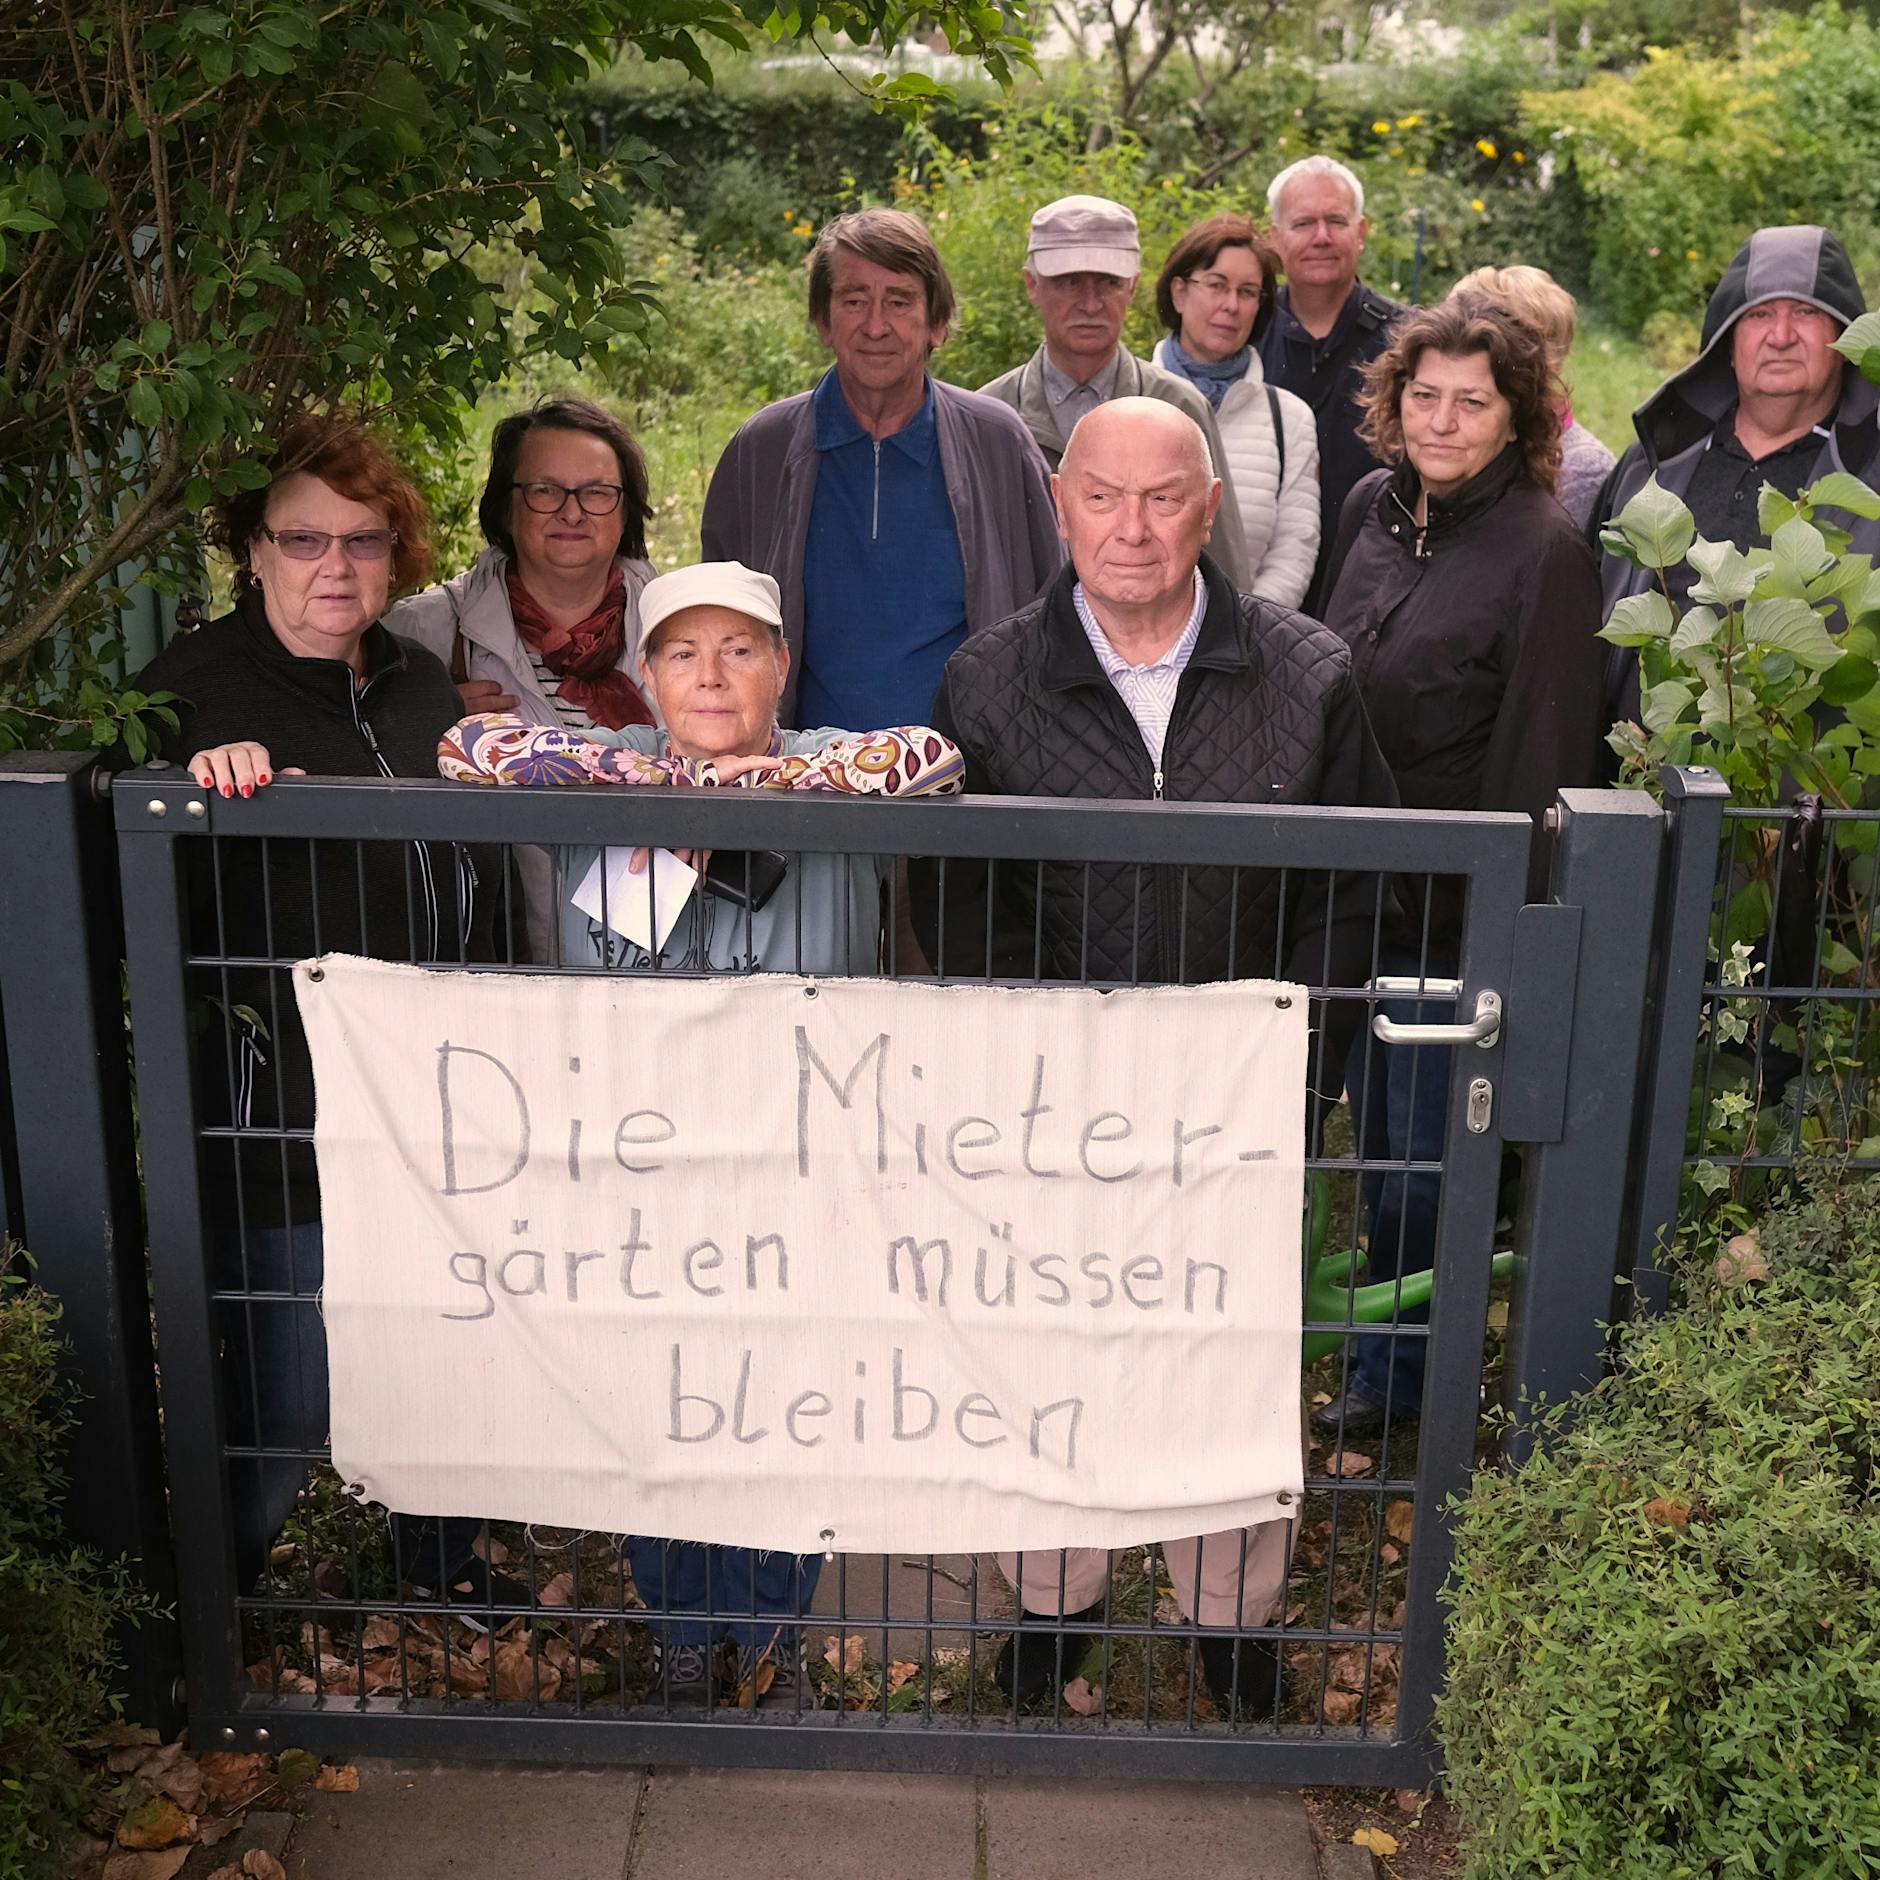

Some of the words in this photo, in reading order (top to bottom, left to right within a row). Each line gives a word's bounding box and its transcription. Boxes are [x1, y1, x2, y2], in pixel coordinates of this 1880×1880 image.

[437, 1040, 676, 1196] Die
[795, 1026, 1277, 1186] Mieter-
[441, 1209, 787, 1320] gärten
[888, 1222, 1227, 1312] müssen
[668, 1344, 1083, 1467] bleiben
